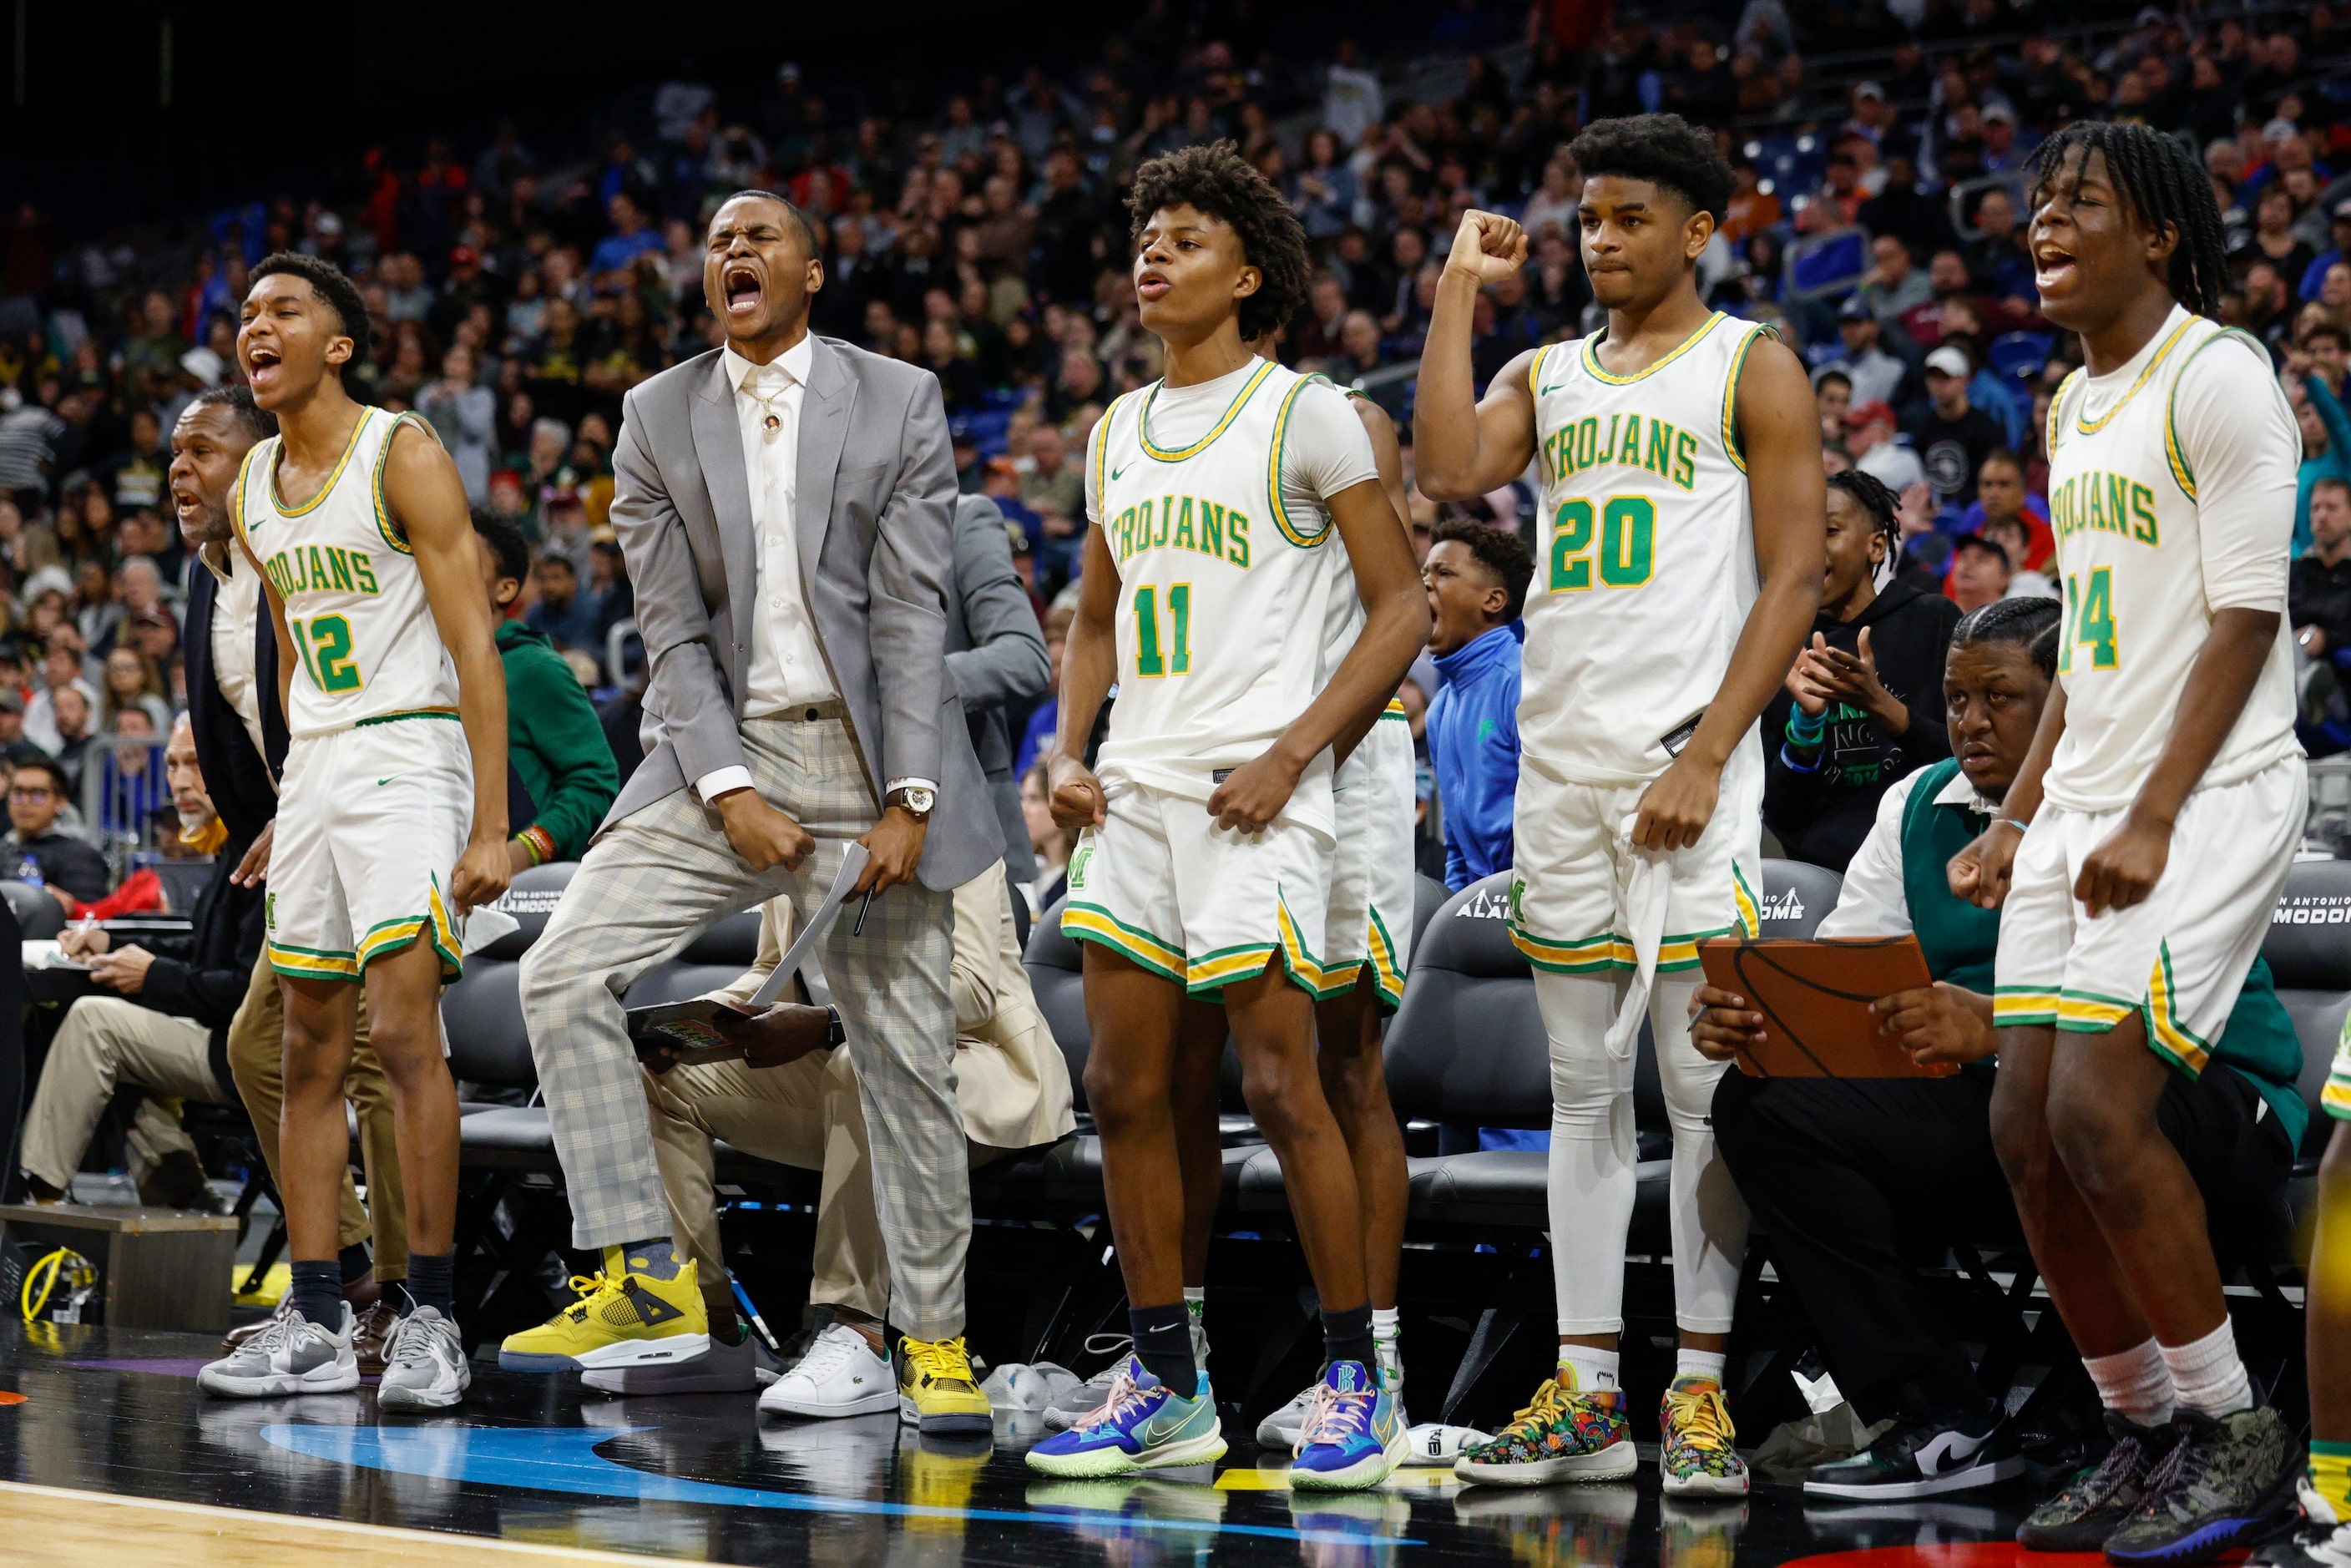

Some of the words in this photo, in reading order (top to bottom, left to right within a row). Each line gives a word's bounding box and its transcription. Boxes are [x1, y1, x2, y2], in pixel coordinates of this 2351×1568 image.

[1549, 494, 1657, 594] 20
[292, 613, 363, 695] 12
[1132, 583, 1191, 678] 11
[2058, 565, 2119, 675] 14
[2293, 897, 2351, 906] ANTONIO
